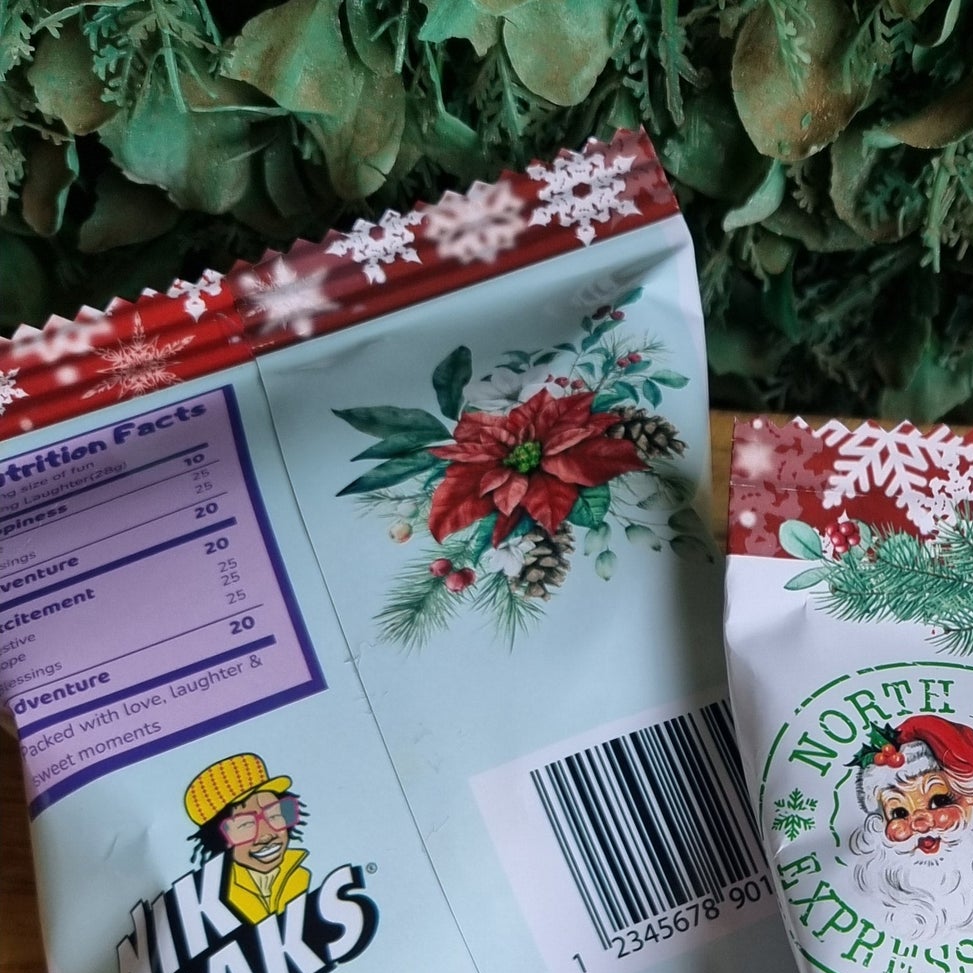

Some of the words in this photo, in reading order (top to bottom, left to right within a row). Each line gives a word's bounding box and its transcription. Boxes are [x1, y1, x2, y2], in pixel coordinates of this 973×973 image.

[113, 404, 206, 445] Facts
[184, 453, 205, 467] 10
[194, 502, 219, 520] 20
[204, 537, 230, 556] 20
[218, 558, 238, 573] 25
[220, 571, 241, 587] 25
[227, 590, 247, 606] 25
[229, 615, 256, 636] 20
[79, 709, 120, 732] with
[123, 690, 168, 716] love,
[169, 665, 244, 701] laughter
[249, 653, 264, 669] &
[788, 678, 956, 777] NORTH
[32, 753, 76, 788] sweet
[78, 720, 162, 762] moments
[572, 953, 588, 973] 1
[611, 896, 721, 960] 2345678
[729, 873, 775, 910] 901
